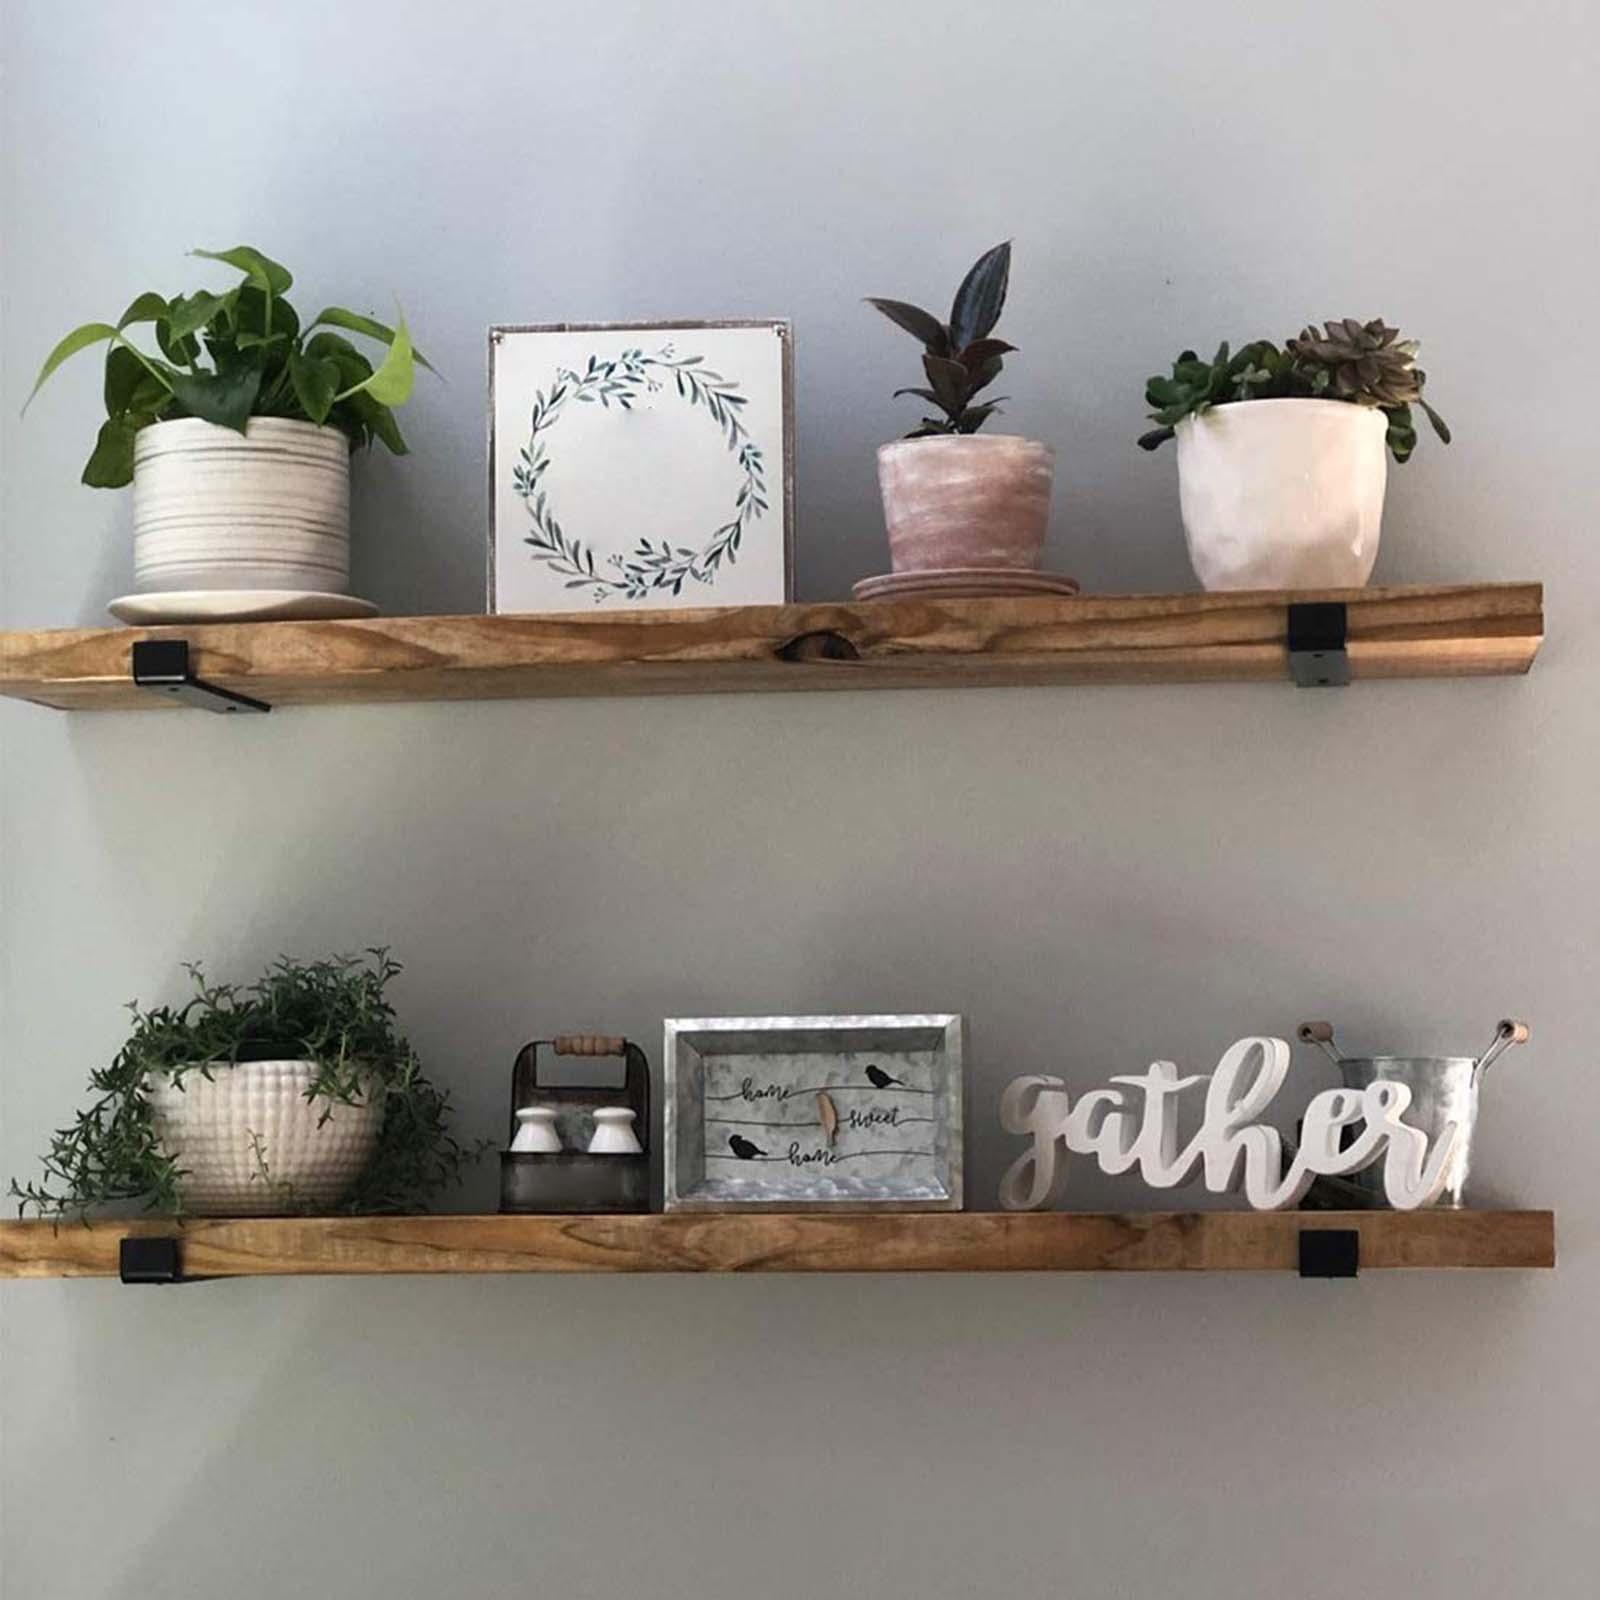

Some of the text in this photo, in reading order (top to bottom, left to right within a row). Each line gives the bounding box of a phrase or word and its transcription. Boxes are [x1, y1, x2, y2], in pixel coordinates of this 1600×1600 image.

[741, 1077, 792, 1102] home
[849, 1106, 900, 1128] sweet
[1001, 1037, 1459, 1210] gather
[788, 1142, 839, 1167] home
